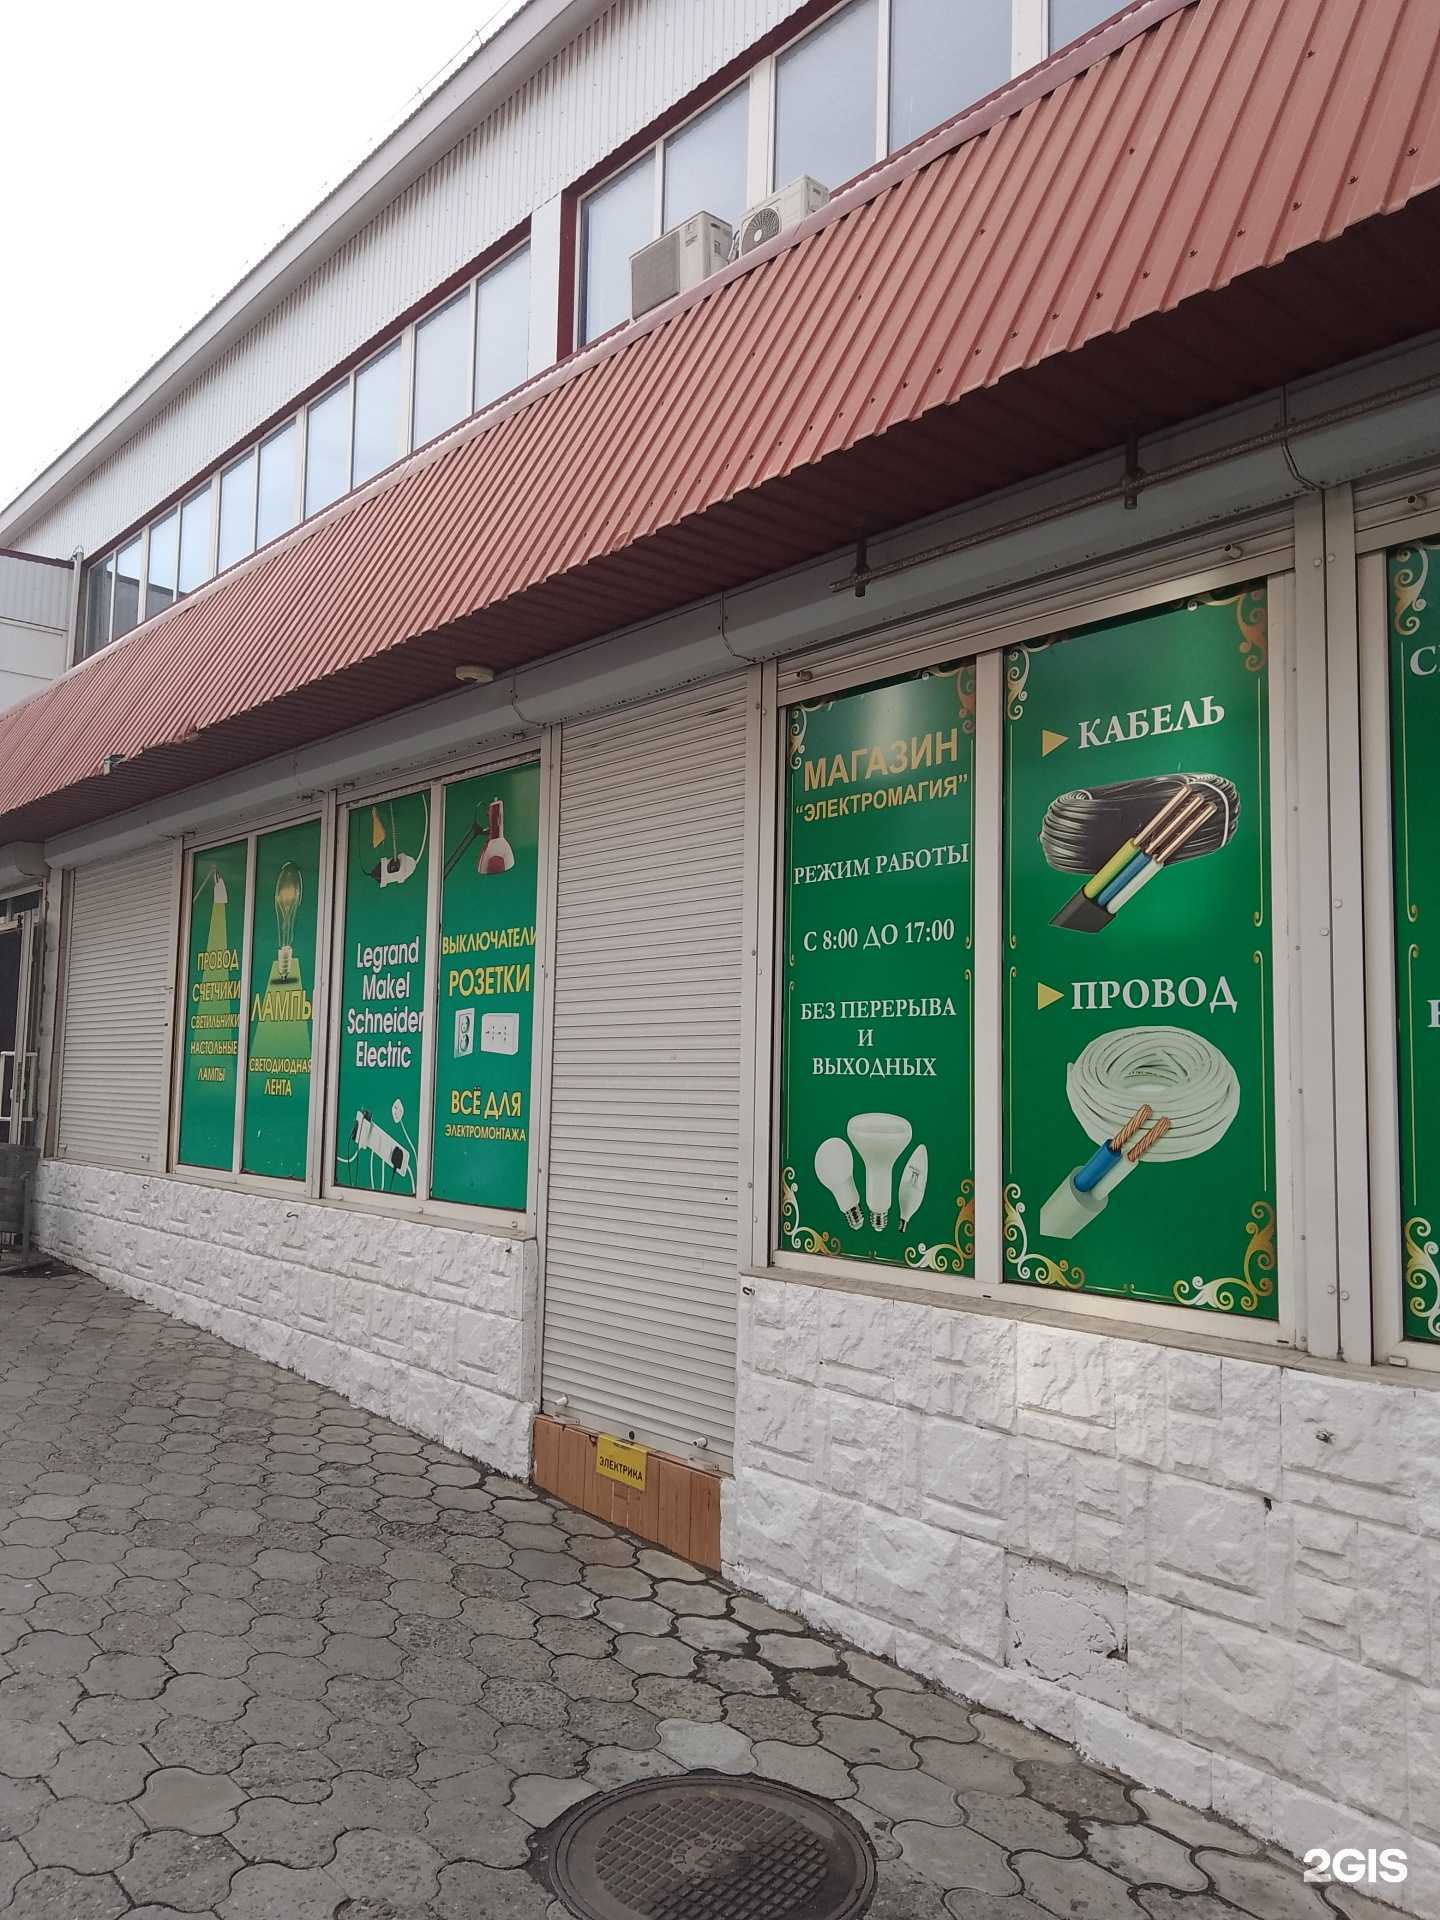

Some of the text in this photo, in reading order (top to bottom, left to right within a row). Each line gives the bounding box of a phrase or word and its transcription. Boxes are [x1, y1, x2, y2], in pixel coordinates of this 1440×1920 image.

[1077, 695, 1226, 750] КАБЕЛЬ
[803, 728, 958, 793] МАГАЗИН
[793, 843, 969, 885] РЕЖИМ РАБОТЫ
[803, 918, 955, 952] С 8:00 ДО 17:00
[197, 949, 239, 971] ПРОВОД
[356, 935, 420, 972] Legrand
[192, 980, 241, 1002] СЧЕТЧИКИ
[362, 971, 411, 1001] Makel
[448, 964, 530, 997] РОЗЕТКИ
[1071, 975, 1238, 1014] ПРОВОД
[347, 1006, 424, 1034] Schneider
[800, 997, 957, 1020] БЕЗ ПЕРЕРЫВА
[190, 1040, 238, 1055] НАСТОЛЬНЫЕ
[857, 1029, 874, 1047] И
[249, 1056, 312, 1075] СВЕТОДИОДНАЯ
[355, 1040, 412, 1068] Electric
[812, 1056, 937, 1079] ВЫХОДНЫХ
[197, 1066, 225, 1082] ЛАМПЫ
[264, 1078, 292, 1096] ЛЕНТА
[451, 1085, 522, 1120] ВСЁ ДЛЯ
[444, 1123, 527, 1141] ЭЛЕКТРОМОНТАЖА
[599, 1455, 643, 1481] ЭЛЕКТРИКА
